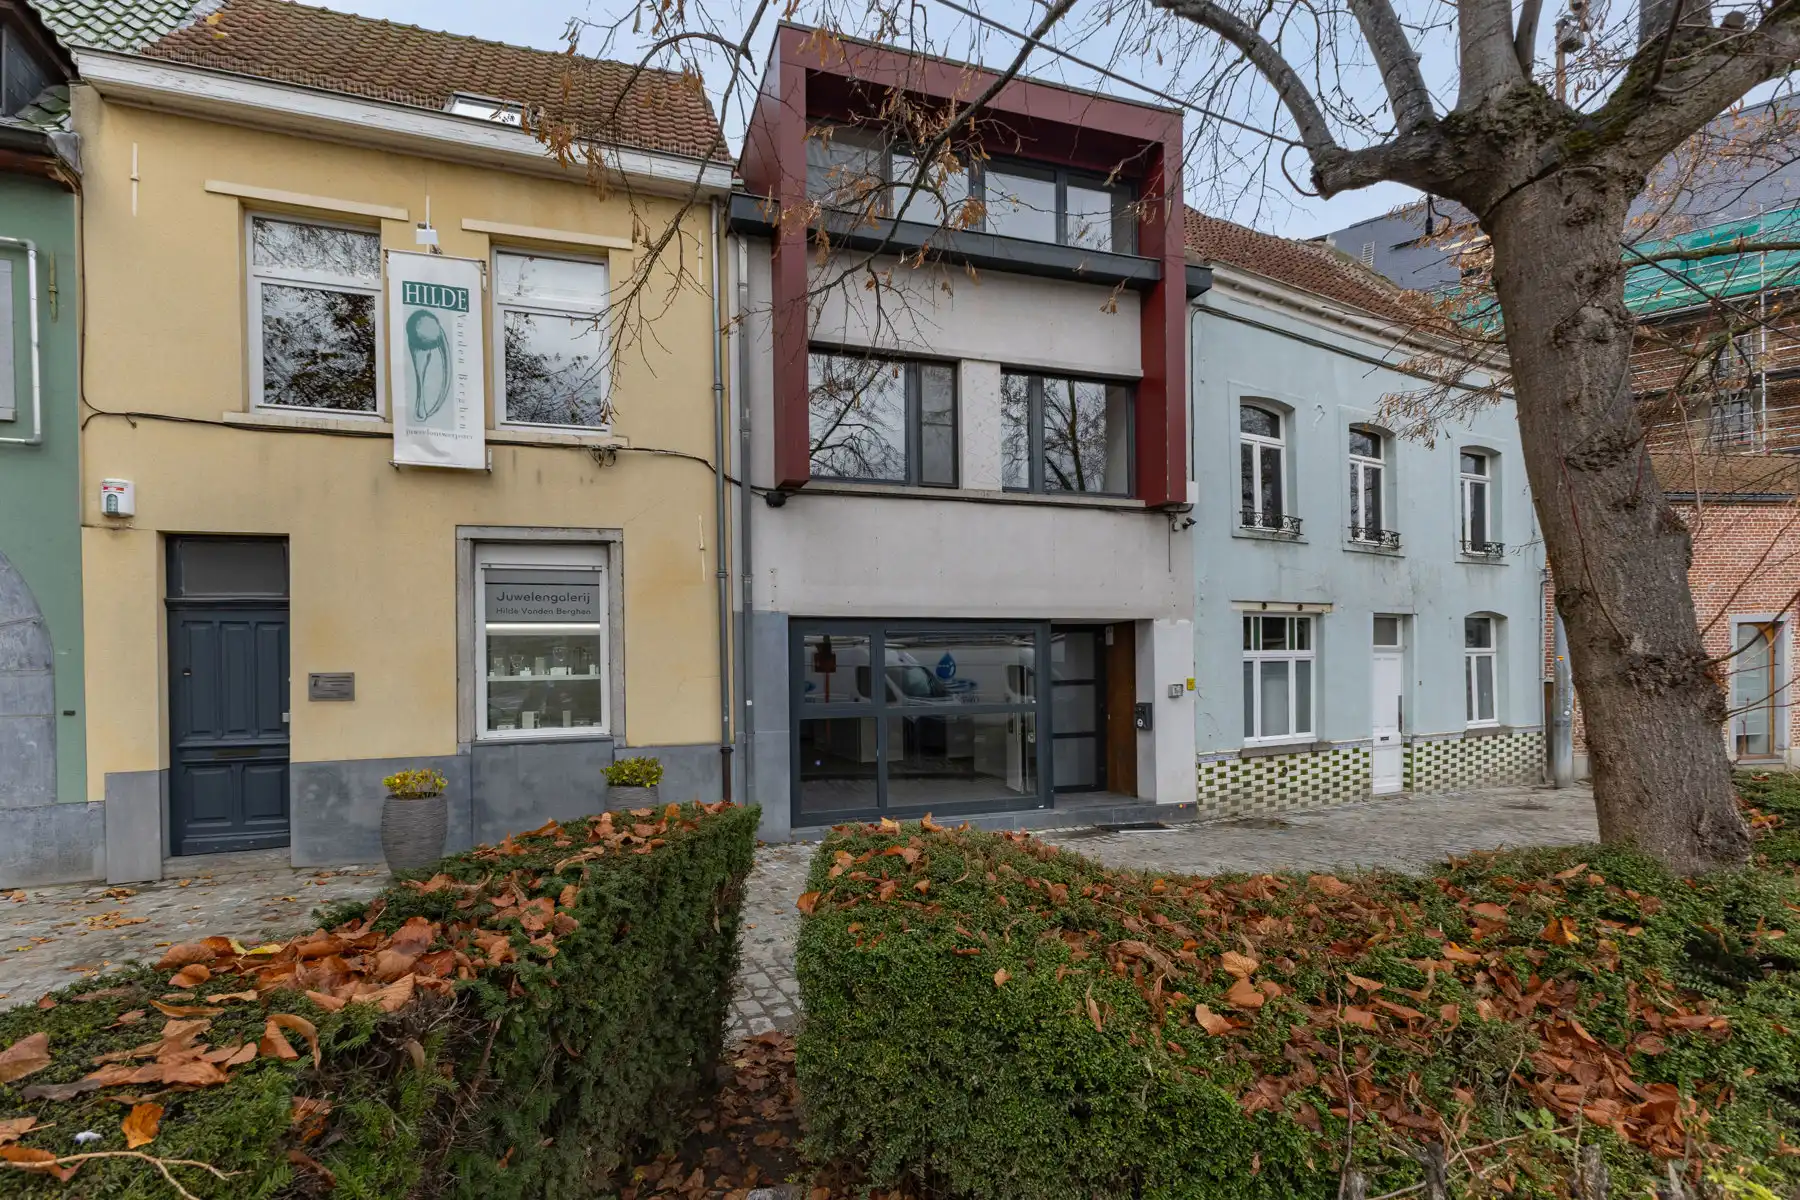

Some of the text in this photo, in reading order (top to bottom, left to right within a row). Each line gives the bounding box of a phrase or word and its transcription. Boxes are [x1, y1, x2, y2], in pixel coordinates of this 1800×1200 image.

[404, 282, 468, 310] HILDE
[456, 314, 469, 430] Vanden Berghen
[496, 591, 590, 604] Juwelengalerij
[496, 607, 591, 616] Hilde Vanden Berghen
